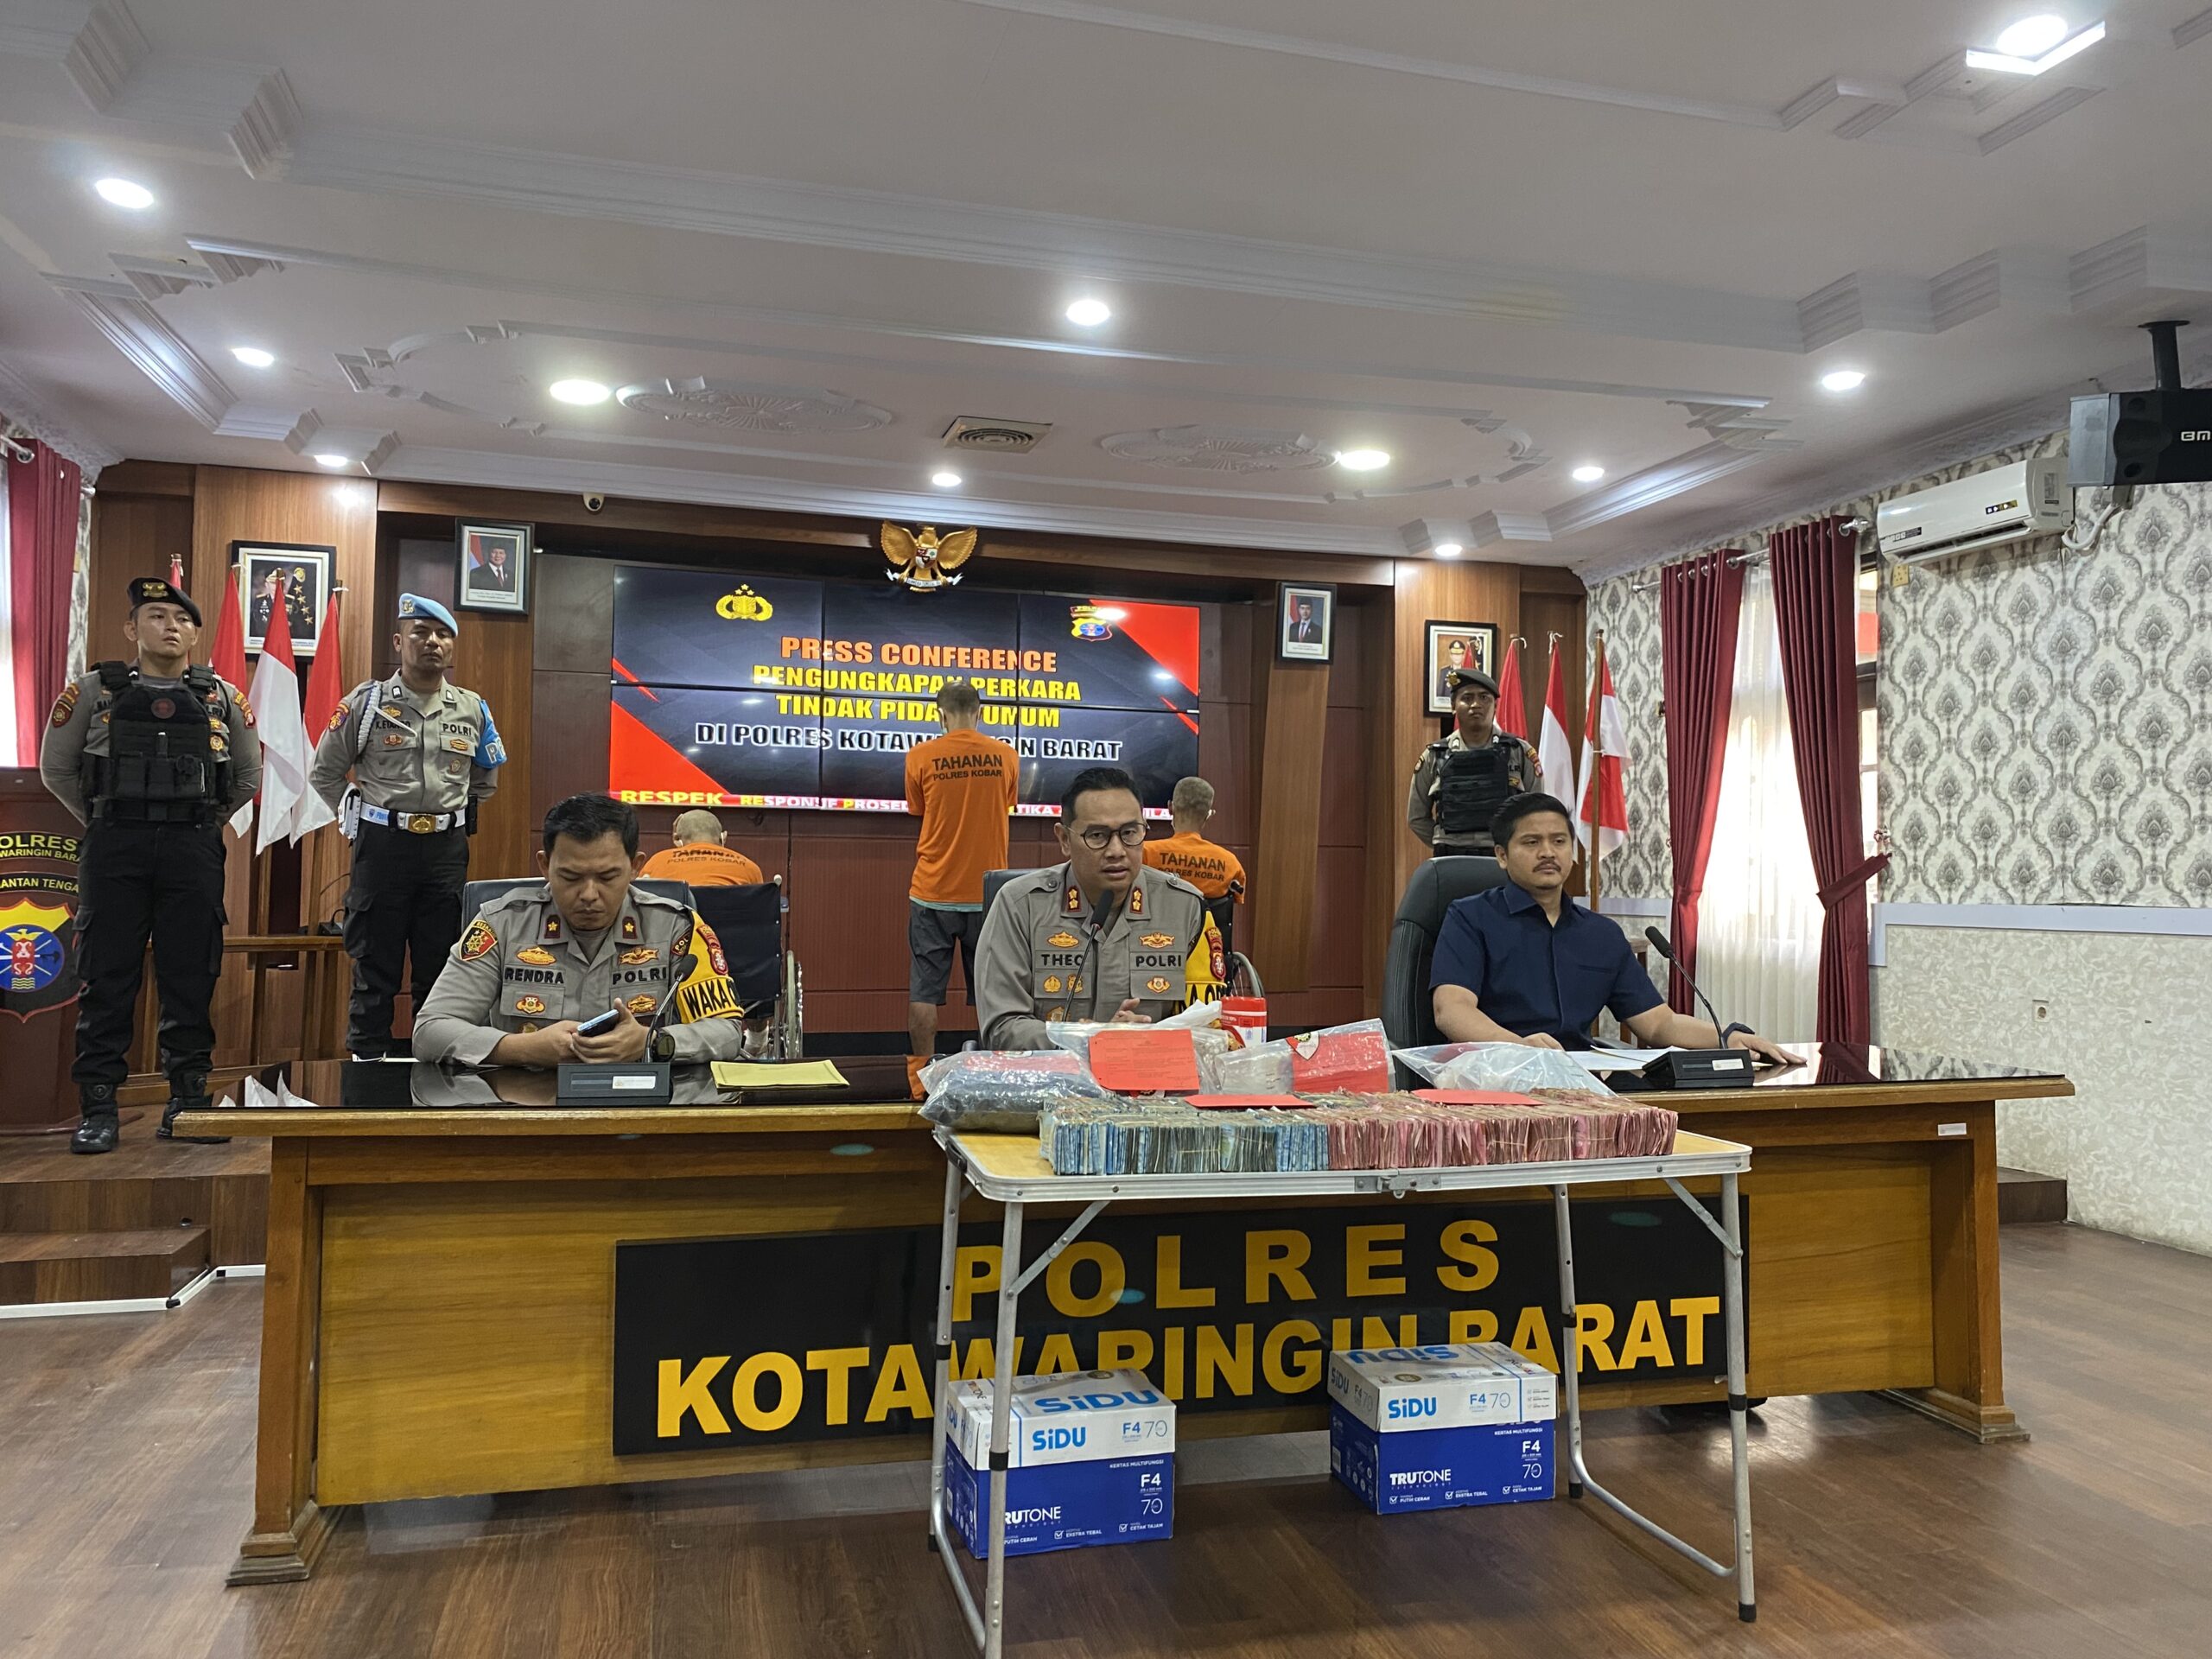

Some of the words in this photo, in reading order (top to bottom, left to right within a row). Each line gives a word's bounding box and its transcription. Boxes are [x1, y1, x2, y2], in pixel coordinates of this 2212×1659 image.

[780, 636, 874, 664] PRESS
[880, 643, 1058, 673] CONFERENCE
[753, 664, 963, 694] PENGUNGKAPA
[970, 677, 1082, 702] PERKARA
[776, 694, 874, 719] TINDAK
[880, 701, 941, 722] PIDA
[982, 705, 1060, 728] UMUM
[442, 722, 472, 735] POLRI
[695, 722, 727, 745] DI
[732, 724, 833, 750] POLRES
[1042, 737, 1123, 762] BARAT
[931, 754, 1002, 772] TAHANAN
[933, 771, 969, 781] POLRES
[971, 769, 1002, 778] KOBAR
[620, 790, 724, 805] RESPEK
[1160, 852, 1225, 873] TAHANAN
[1194, 870, 1224, 881] KOBAR
[1135, 954, 1182, 967] POLRI
[505, 967, 564, 984] RENDRA
[612, 966, 666, 985] POLRI
[683, 978, 731, 1020] WAKA
[951, 1219, 1499, 1322] POLRES
[1034, 1389, 1160, 1413] SiDU
[1388, 1396, 1437, 1419] SiDU
[1470, 1393, 1486, 1405] F4
[1490, 1392, 1510, 1408] 70
[1123, 1421, 1141, 1434] F4
[1144, 1420, 1167, 1438] 70
[1032, 1427, 1086, 1451] SiDU
[1522, 1440, 1541, 1453] F4
[1141, 1472, 1161, 1487] F4
[1389, 1468, 1452, 1486] TRUTONE
[1522, 1463, 1542, 1479] 70
[1005, 1506, 1061, 1524] RUTONE
[1141, 1497, 1163, 1515] 70
